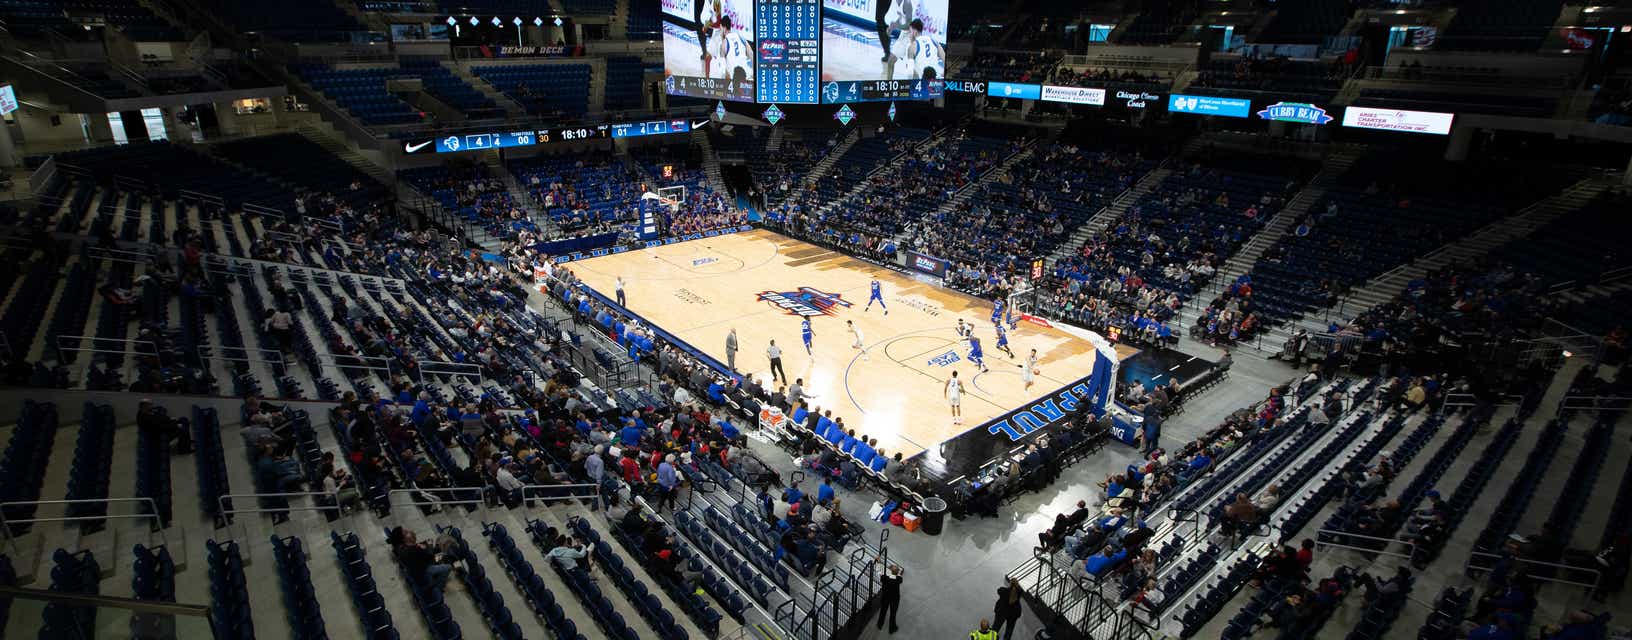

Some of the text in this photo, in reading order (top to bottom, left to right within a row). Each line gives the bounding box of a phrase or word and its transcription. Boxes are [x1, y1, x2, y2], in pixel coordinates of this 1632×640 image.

[500, 46, 565, 55] DEMON DECK
[698, 79, 715, 89] 18:10
[728, 81, 734, 94] 4
[849, 83, 857, 95] 4
[876, 81, 899, 92] 18:10
[915, 81, 922, 92] 4
[964, 82, 985, 93] EMC
[1127, 100, 1146, 108] Coach
[1269, 106, 1321, 121] CUBBY BEAR
[617, 128, 627, 136] 01
[654, 123, 660, 132] 4
[539, 134, 549, 143] 30
[561, 129, 587, 139] 18:10
[476, 137, 483, 146] 4
[494, 138, 500, 146] 4
[517, 136, 529, 144] 00
[1032, 267, 1041, 280] 30
[1109, 332, 1118, 340] 30
